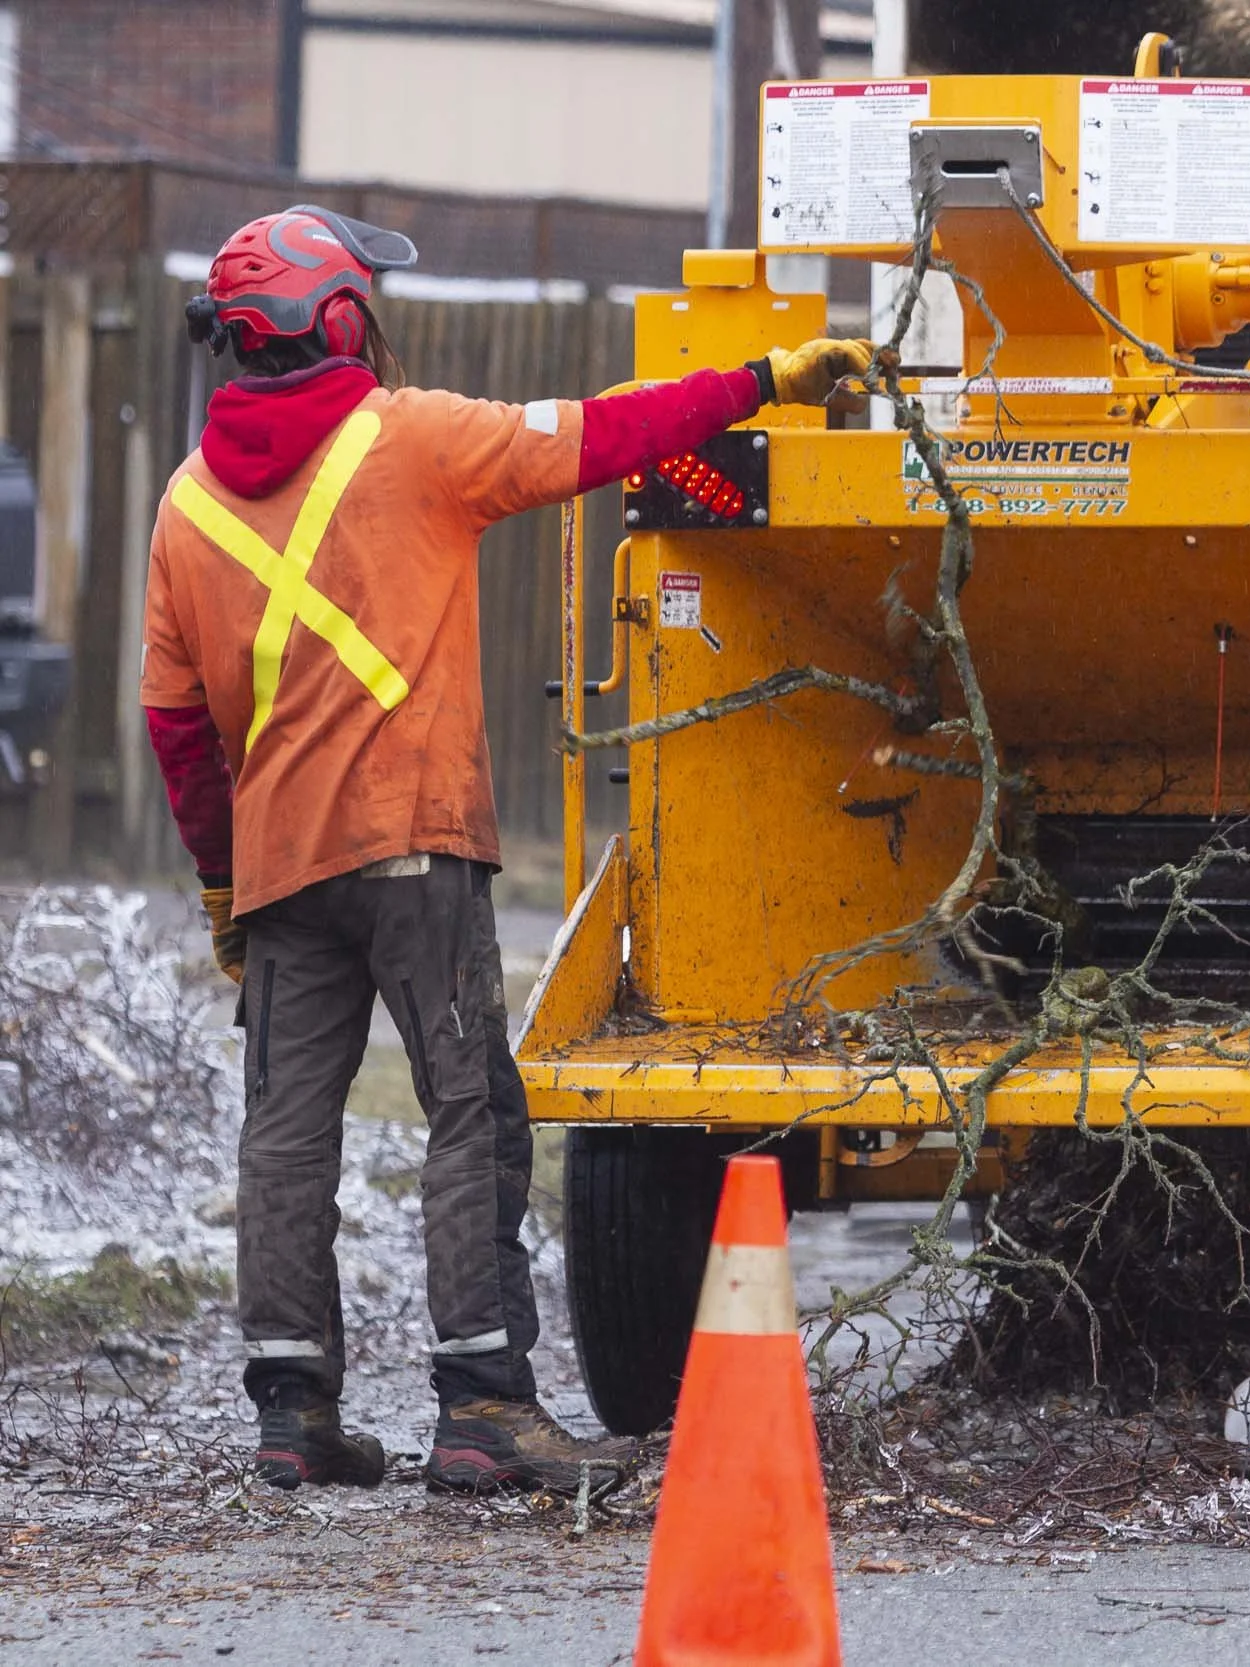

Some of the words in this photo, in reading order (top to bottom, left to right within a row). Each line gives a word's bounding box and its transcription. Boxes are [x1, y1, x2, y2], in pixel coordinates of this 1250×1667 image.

[798, 87, 835, 97] DANGER
[874, 85, 910, 95] DANGER
[1119, 83, 1159, 93] DANGER
[1205, 86, 1244, 95] DANGER
[946, 441, 1130, 463] POWERTECH
[907, 498, 1128, 514] 1-88-892-7777
